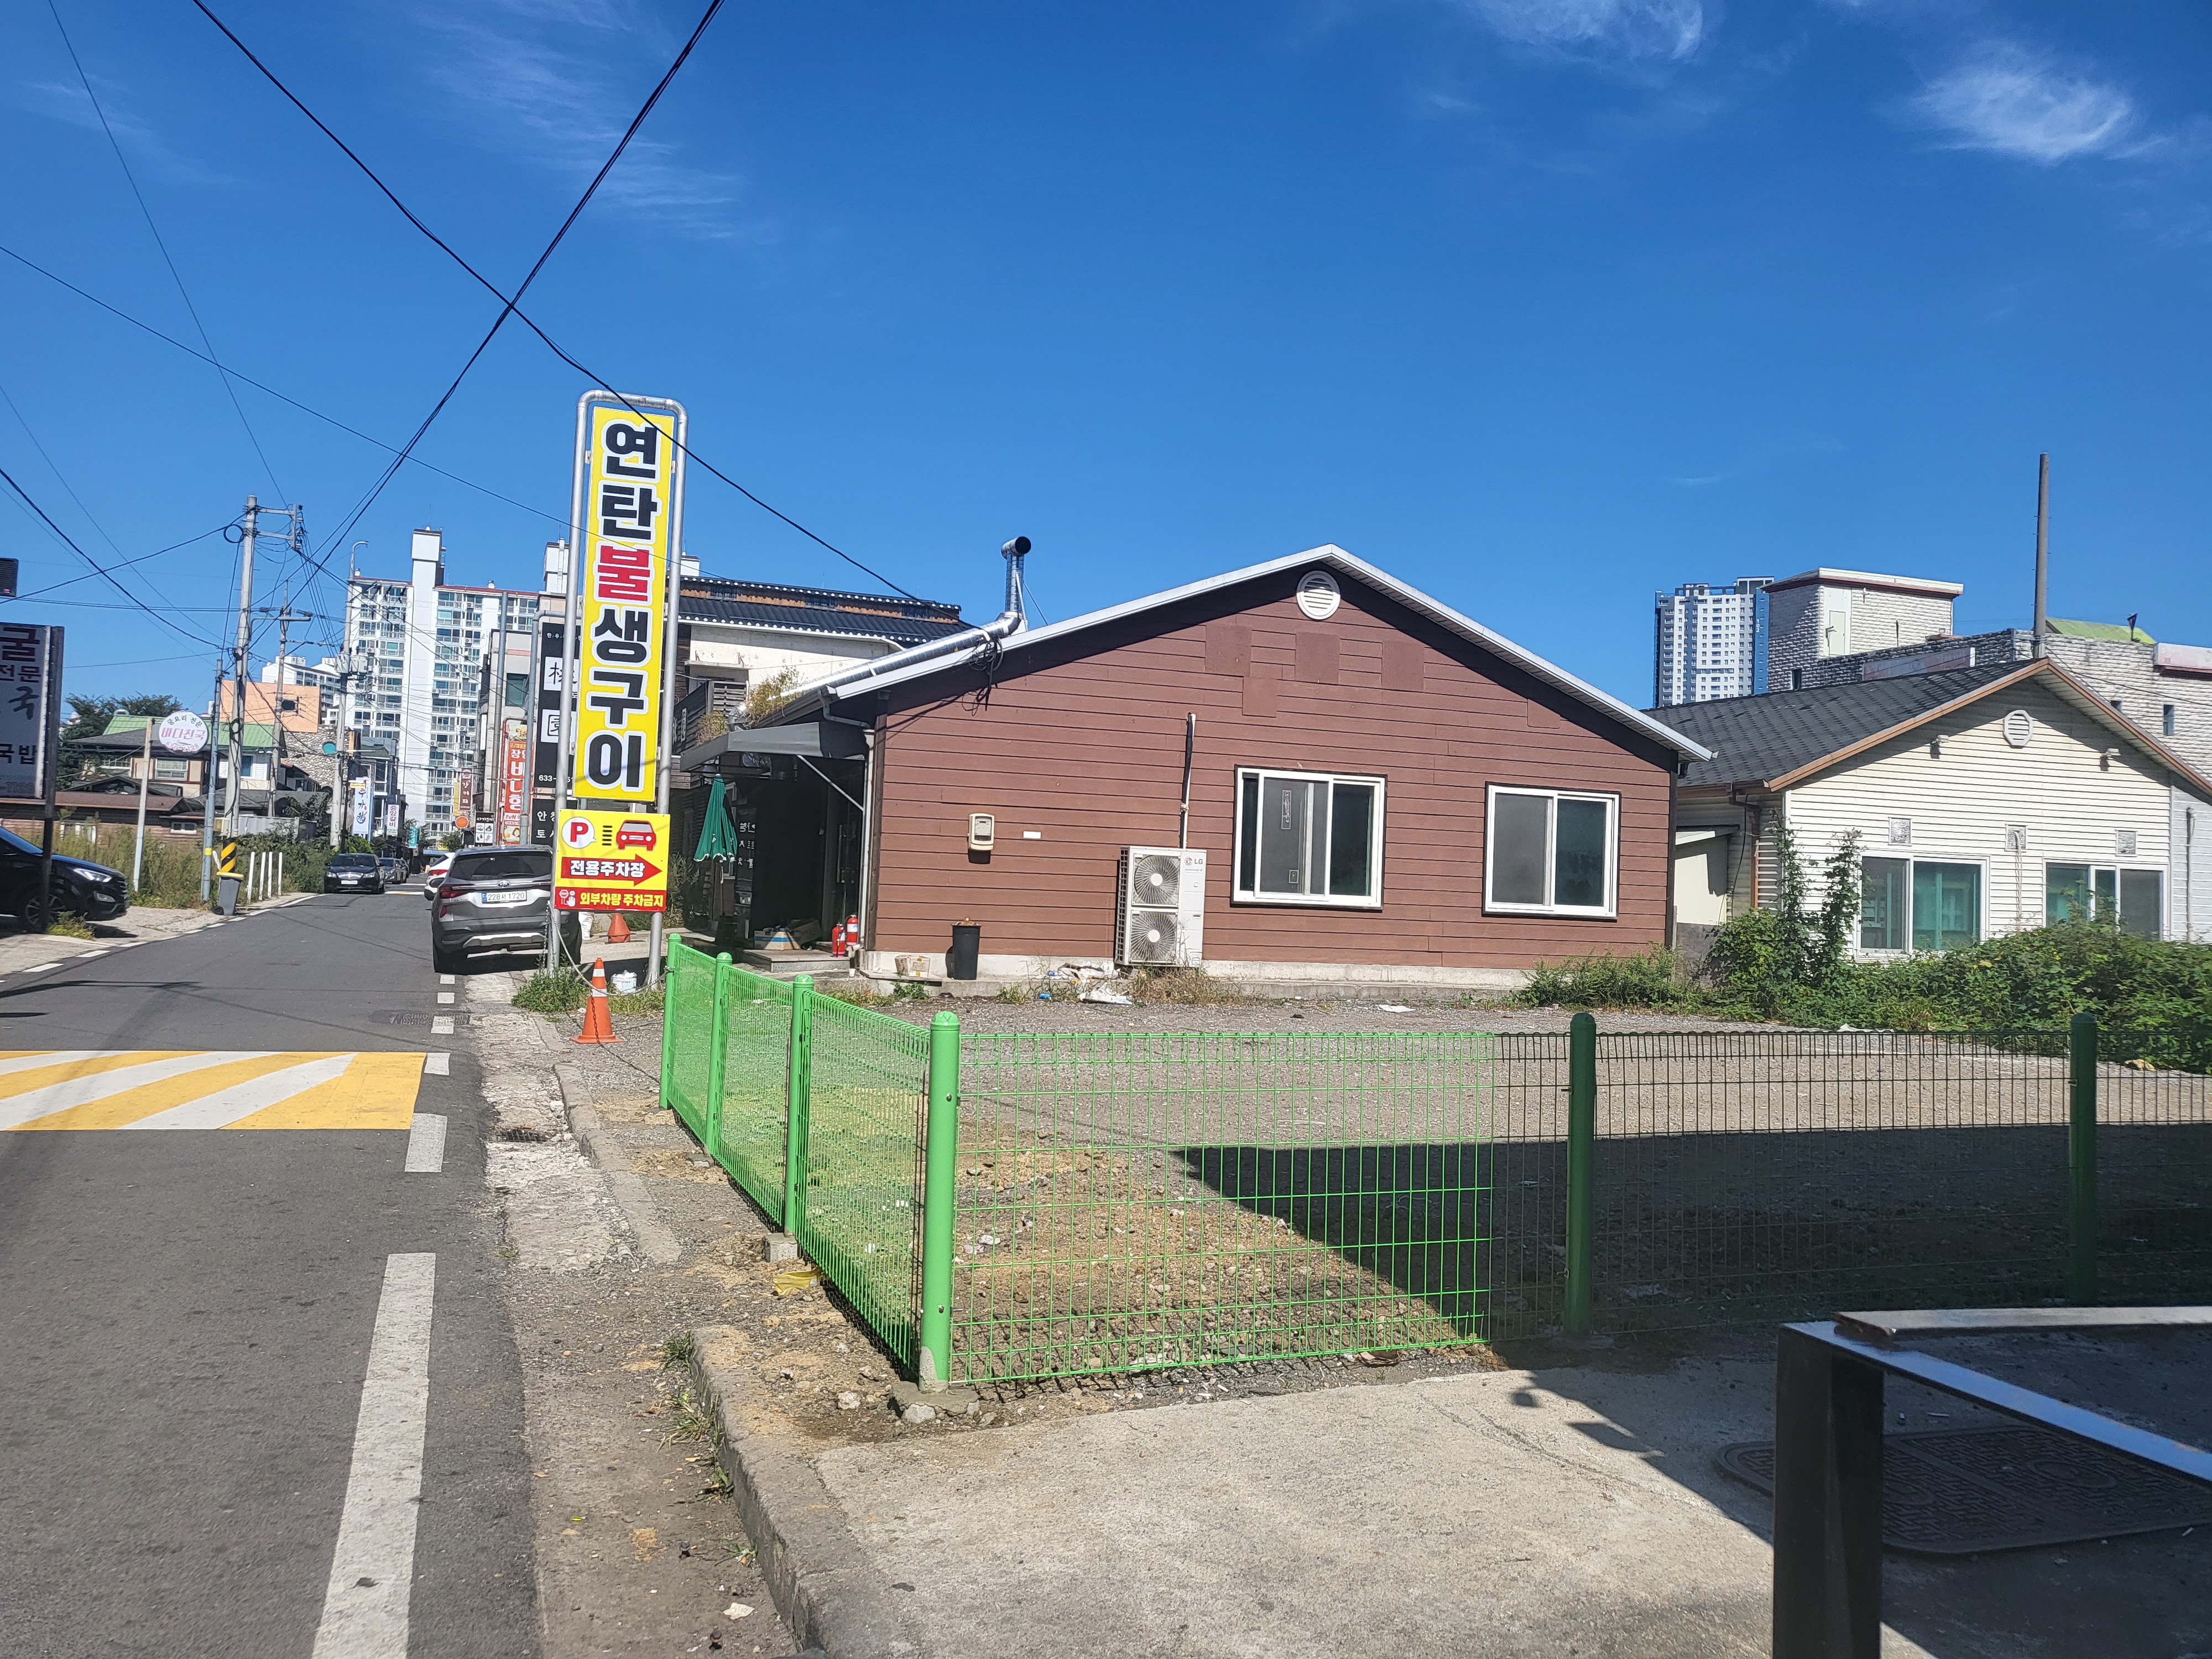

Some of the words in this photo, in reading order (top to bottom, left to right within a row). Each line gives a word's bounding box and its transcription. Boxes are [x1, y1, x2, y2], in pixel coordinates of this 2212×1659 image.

[0, 627, 40, 662] 굴
[161, 727, 206, 740] 바다천국
[0, 743, 38, 765] 국밥
[570, 822, 588, 842] P
[570, 860, 645, 878] 전용주차장
[580, 892, 622, 906] 외부차량
[623, 894, 664, 907] 주차금지
